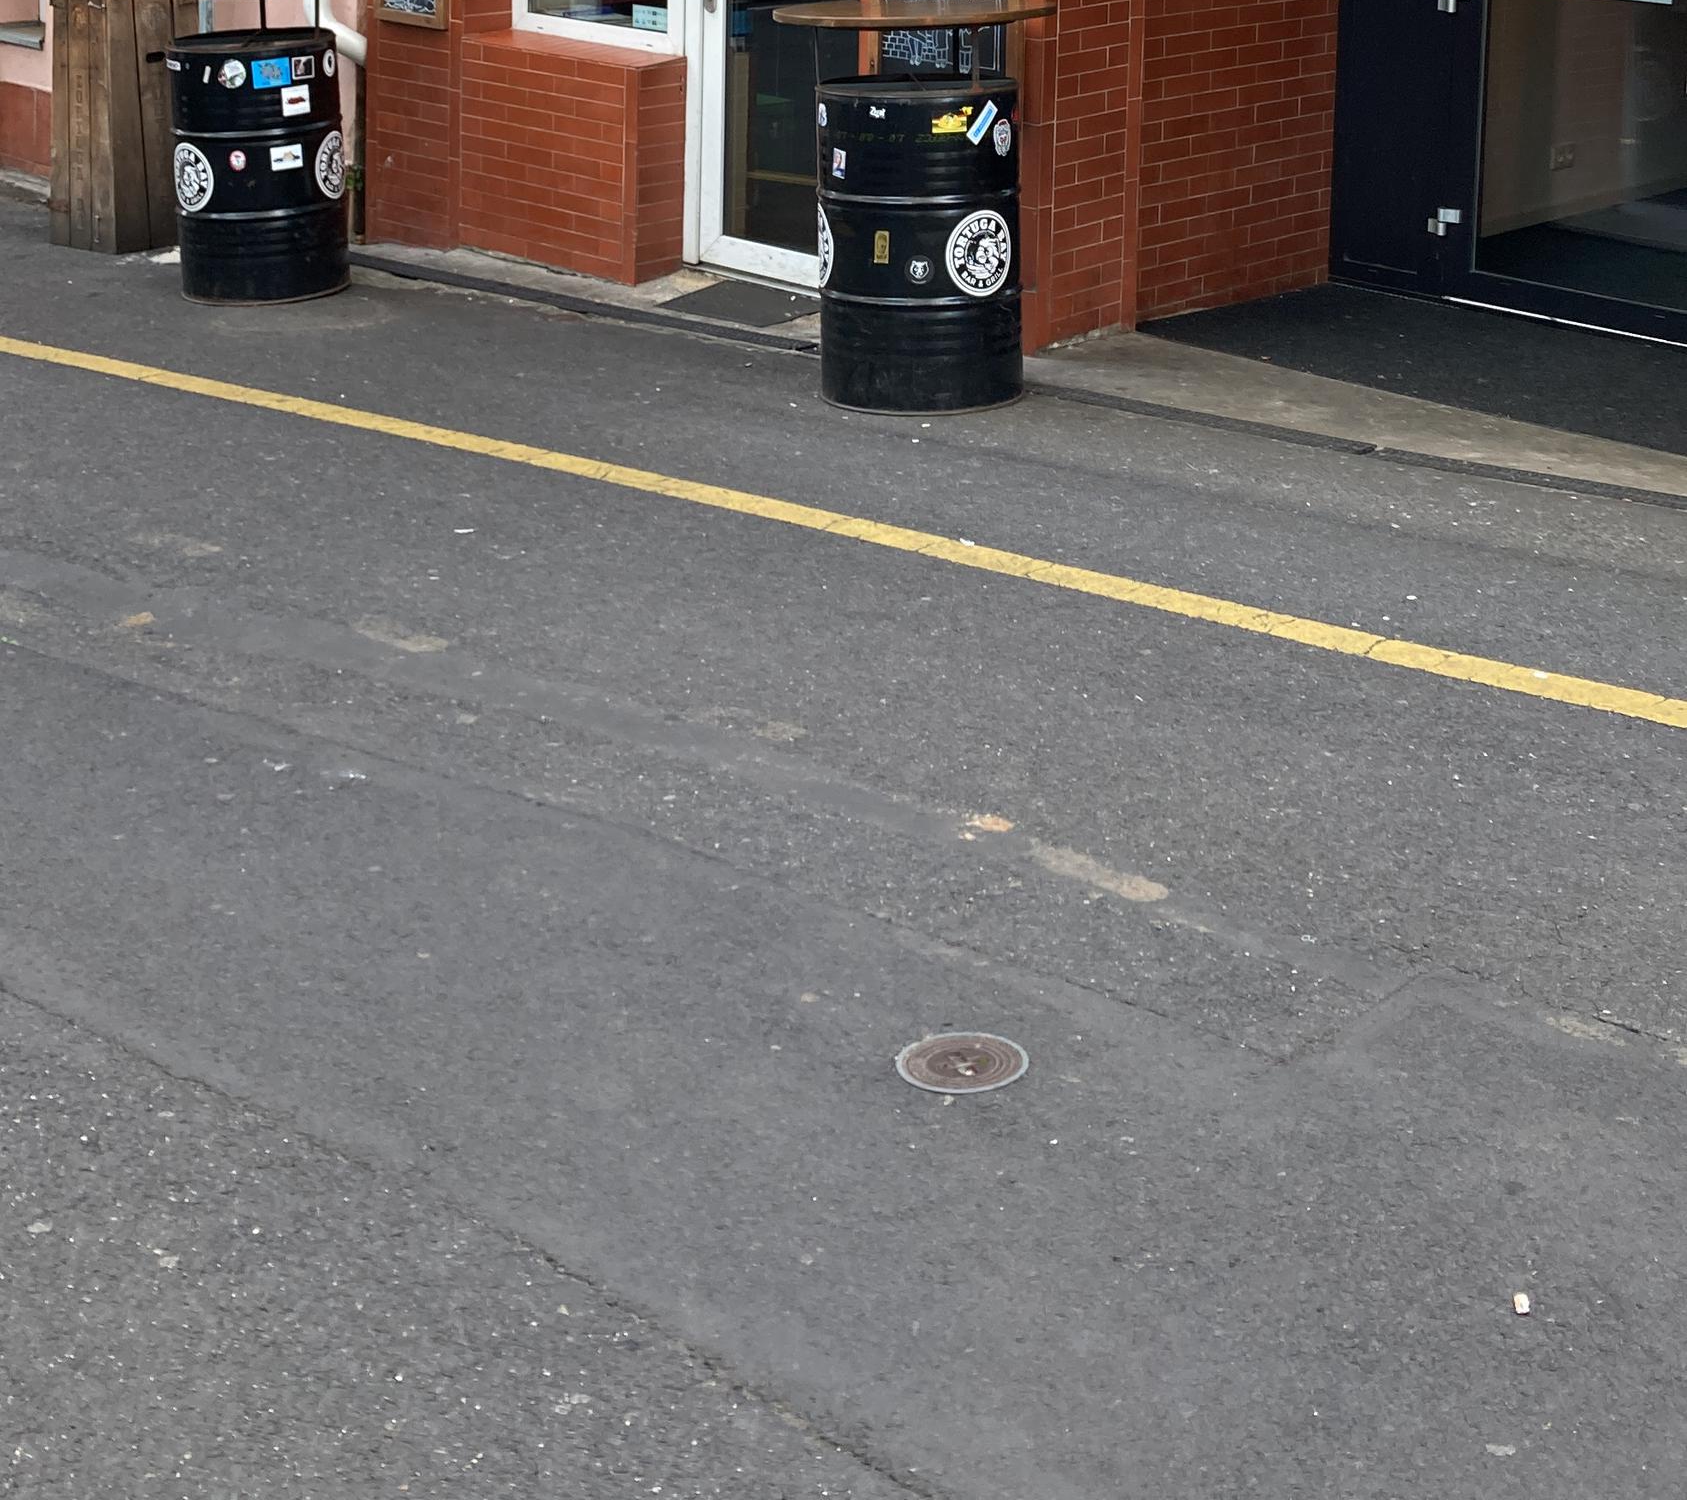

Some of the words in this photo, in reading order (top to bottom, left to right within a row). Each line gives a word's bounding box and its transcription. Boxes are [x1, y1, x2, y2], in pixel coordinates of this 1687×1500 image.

[953, 218, 996, 268] TORTUGA
[997, 229, 1007, 262] BAY
[961, 270, 977, 286] BAR
[985, 267, 1004, 286] GRILL
